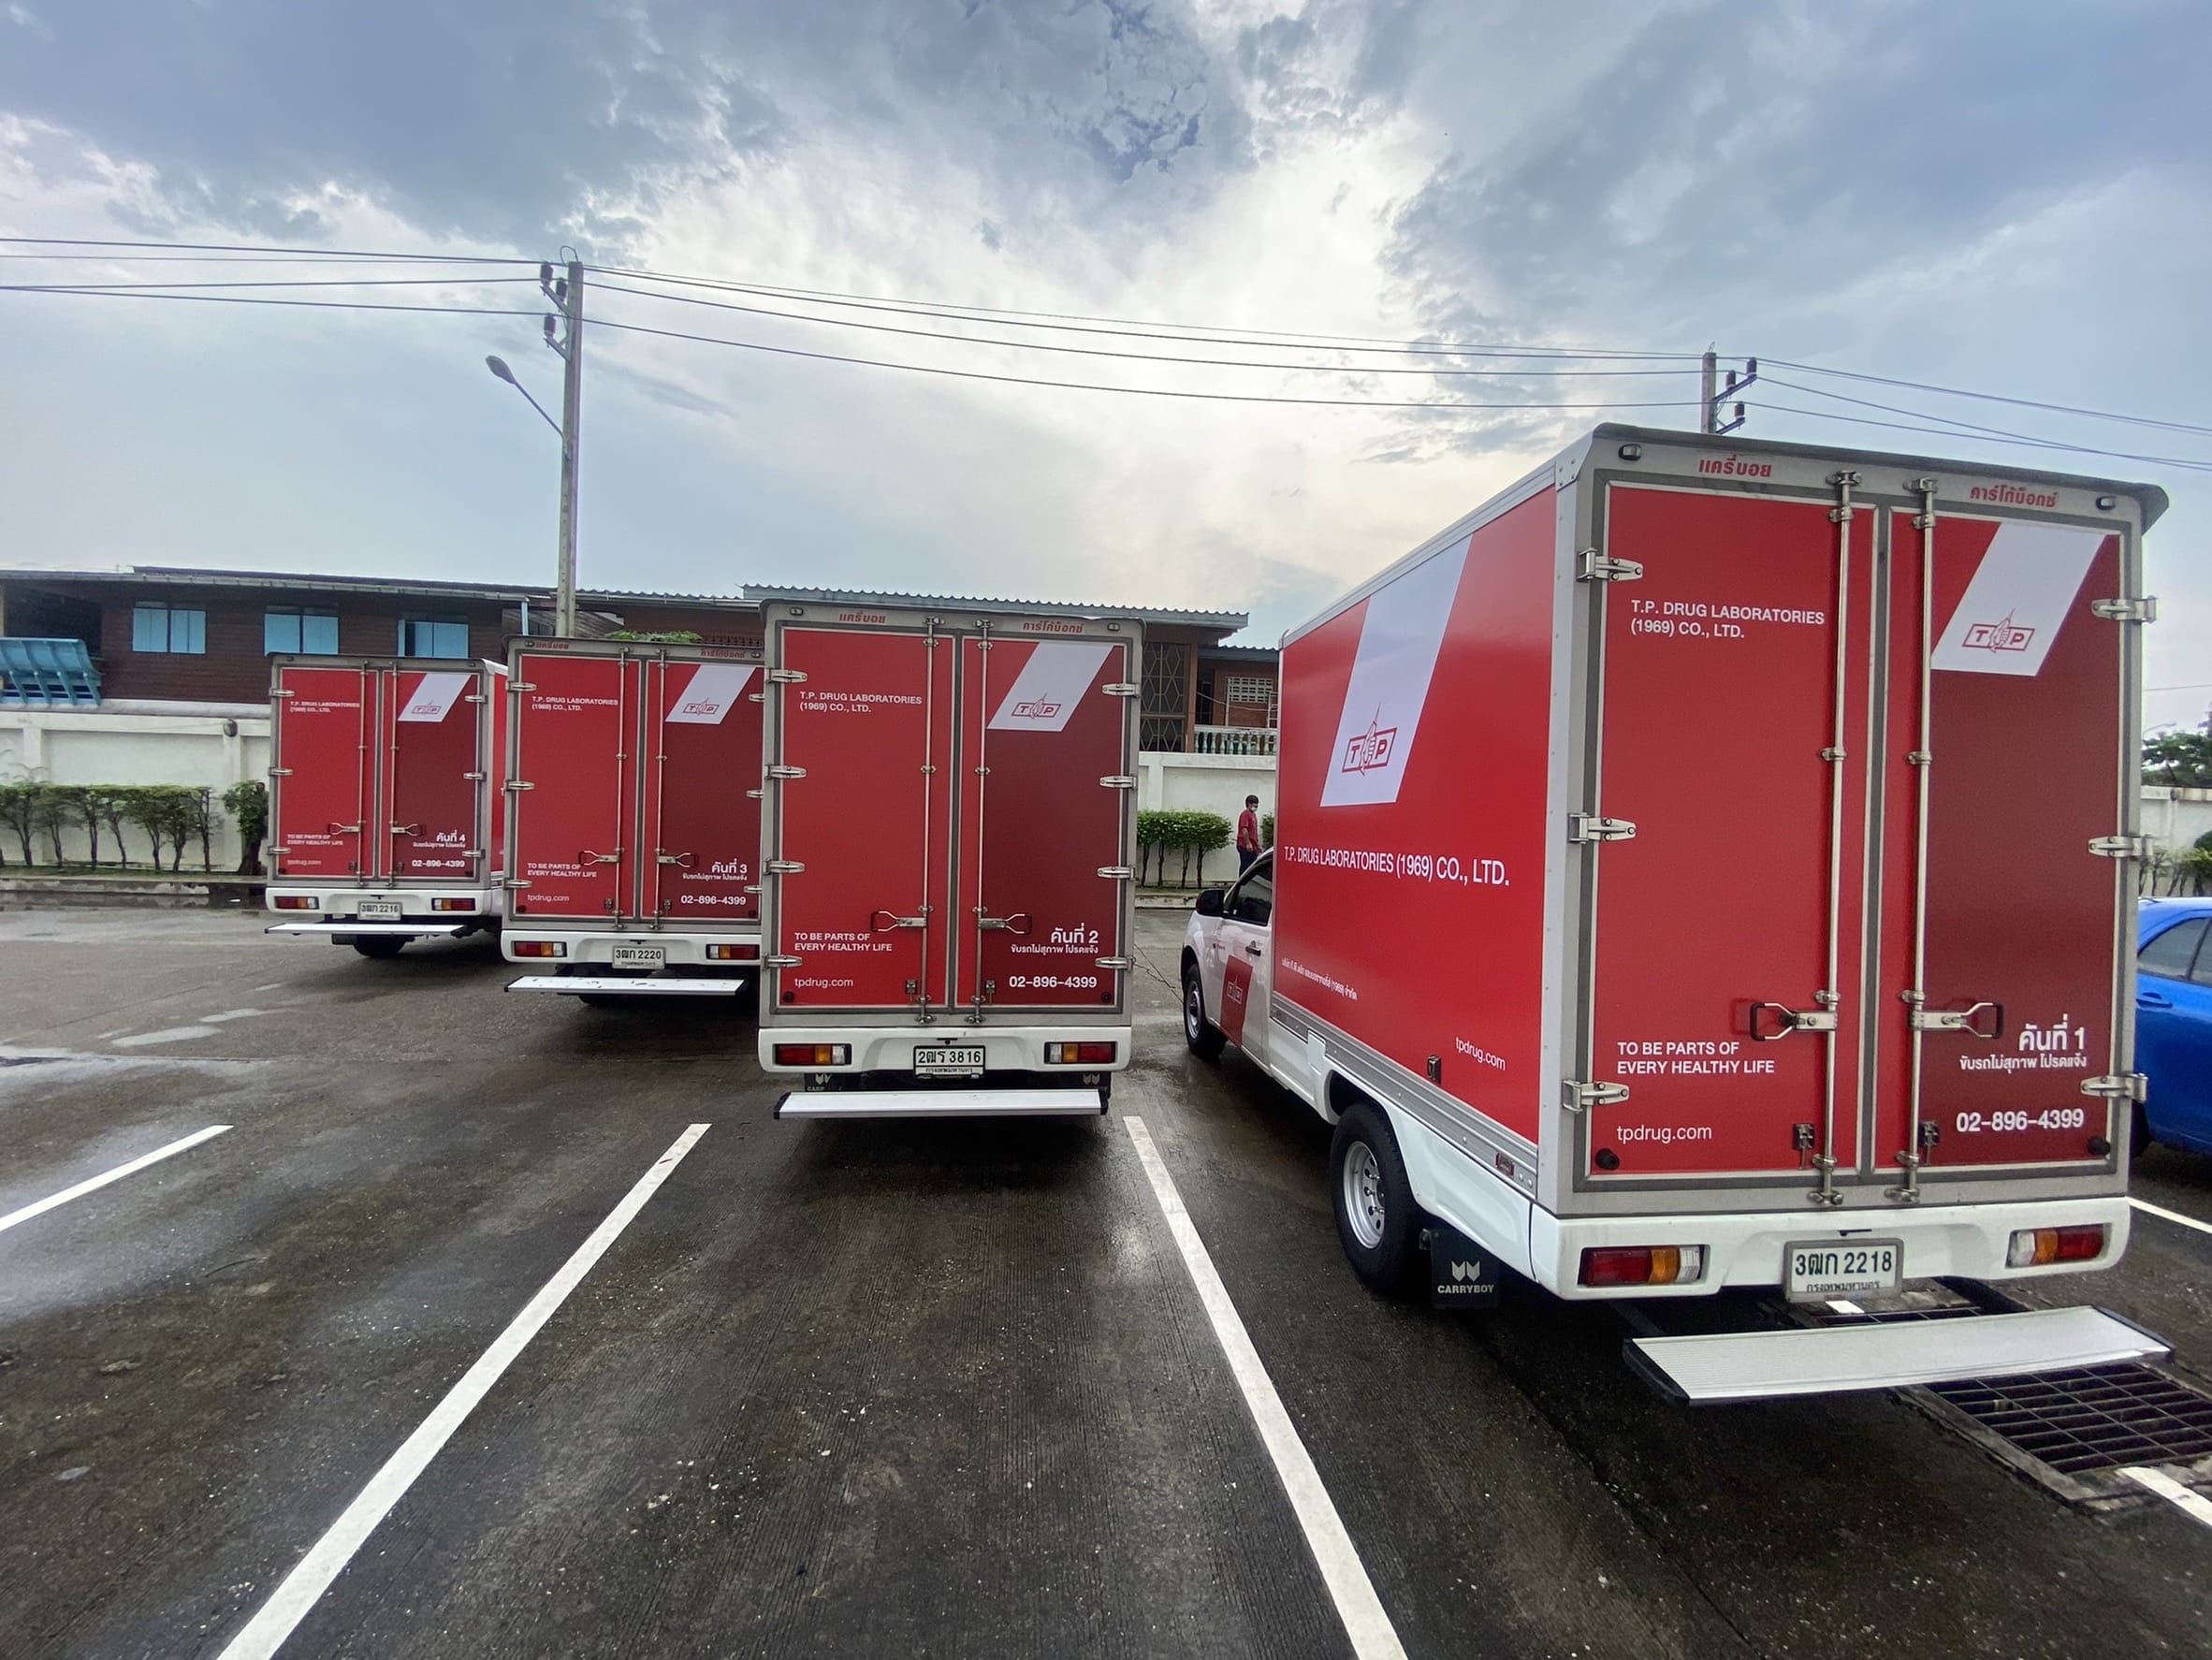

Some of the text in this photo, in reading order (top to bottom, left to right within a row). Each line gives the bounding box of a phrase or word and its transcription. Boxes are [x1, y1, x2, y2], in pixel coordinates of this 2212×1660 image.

[1698, 454, 1772, 477] แครี่บอย
[1631, 600, 1825, 624] T.P. DRUG LABORATORIES
[1630, 618, 1744, 638] (1969) CO., LTD.
[800, 692, 923, 705] T.P. DRUG LABORATORIES
[800, 702, 871, 713] (1969) CO., LTD.
[436, 829, 466, 842] คันที่ 4
[711, 858, 748, 873] คันที่ 3
[1284, 846, 1510, 886] T.P. DRUG LABORATORIES (1969) CO., LTD.
[527, 894, 569, 902] tpdrug.com
[680, 895, 747, 905] 02-896-4399
[794, 932, 808, 940] TO
[809, 932, 822, 940] BE
[824, 932, 855, 940] PARTS
[1050, 922, 1099, 943] คันที่ 2
[794, 942, 825, 951] EVERY
[873, 943, 892, 952] LIFE
[638, 950, 662, 959] 2220
[794, 978, 853, 988] tpdrug.com
[1009, 976, 1097, 988] 02-896-4399
[2018, 1013, 2086, 1051] คันที่ 1
[1455, 1037, 1506, 1071] tpdrug.com
[1617, 1041, 1739, 1055] TO BE PARTS OF
[949, 1051, 981, 1063] 3816
[1617, 1060, 1774, 1074] EVERY HEALTHY LIFE
[1956, 1108, 2085, 1132] 02-896-4399
[1616, 1125, 1712, 1144] tpdrug.com
[1843, 1250, 1892, 1274] 2218
[1437, 1284, 1494, 1294] CARRYBOY
